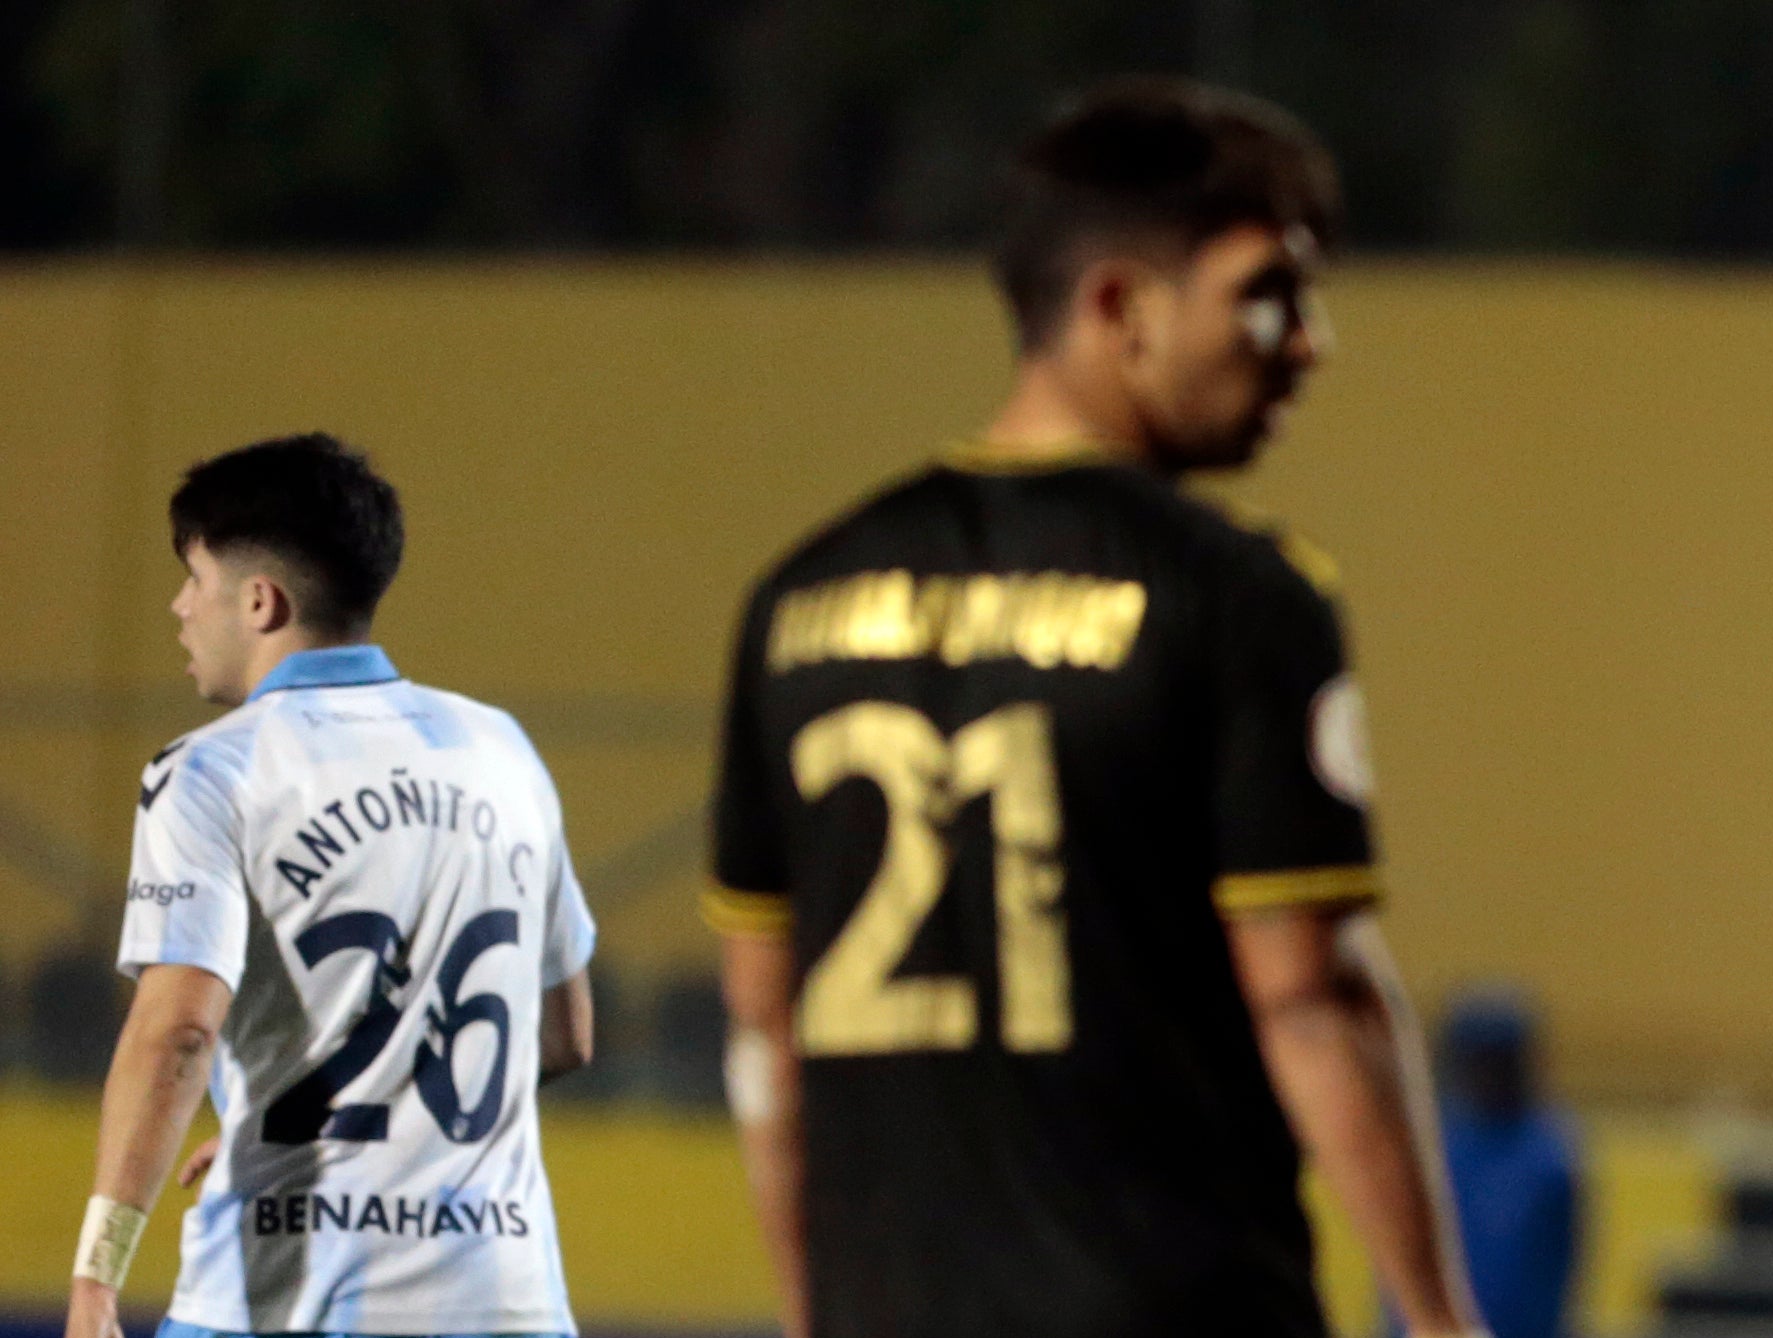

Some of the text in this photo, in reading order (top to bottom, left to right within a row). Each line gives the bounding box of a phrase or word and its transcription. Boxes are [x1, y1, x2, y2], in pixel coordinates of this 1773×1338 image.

[274, 768, 497, 900] ANTOÑITO
[790, 700, 1071, 1056] 21
[262, 909, 519, 1145] 26
[255, 1194, 529, 1239] BENAHAVIS
